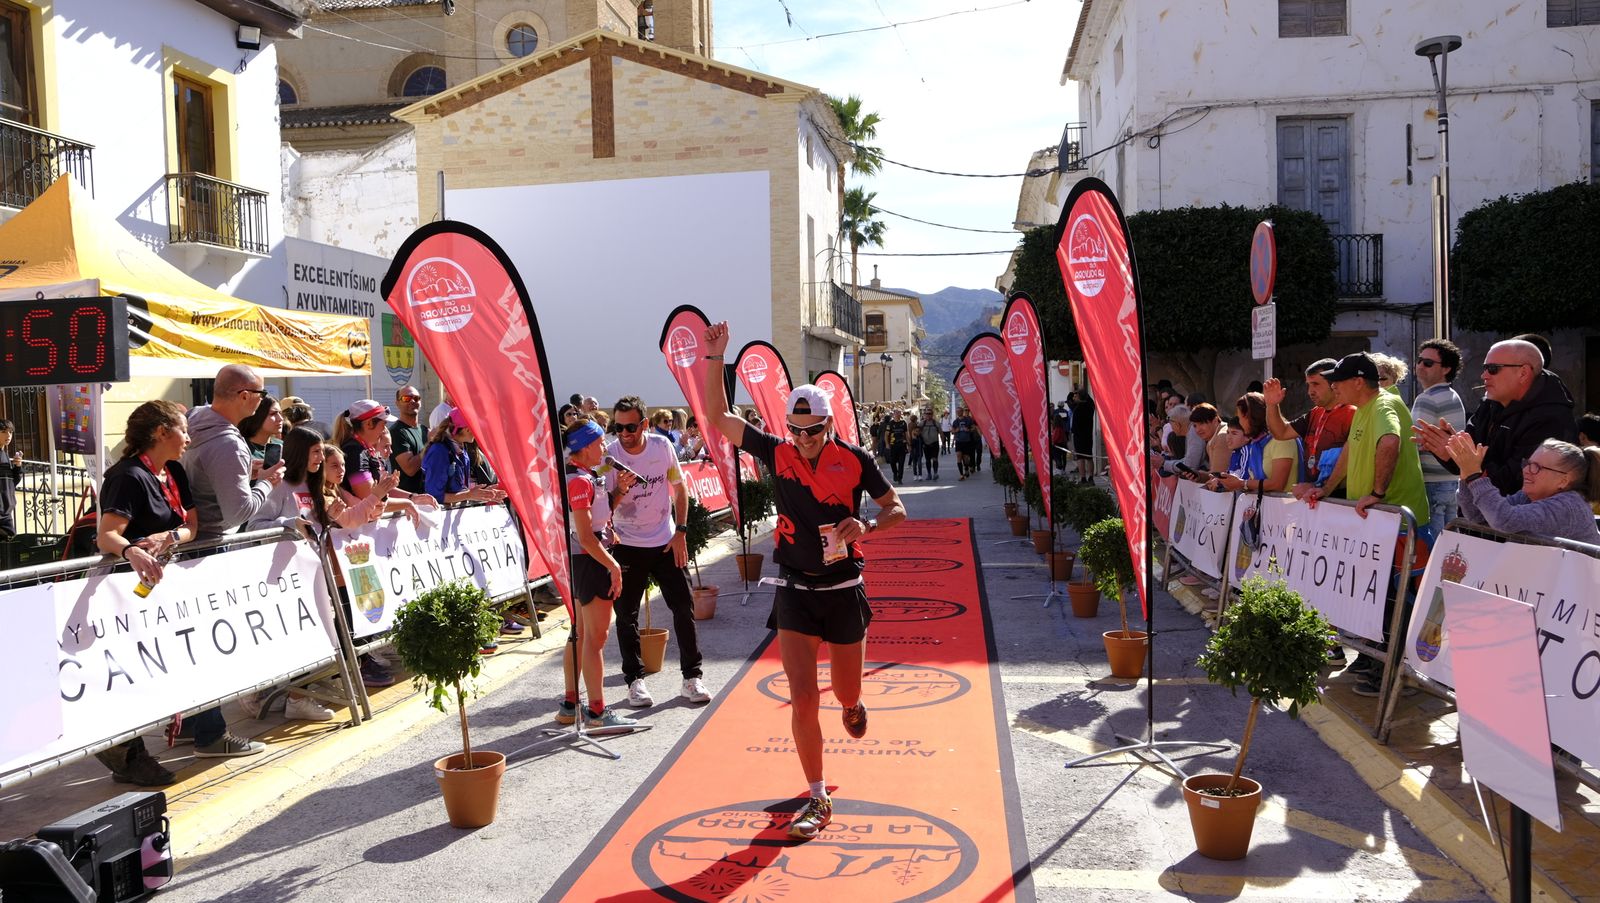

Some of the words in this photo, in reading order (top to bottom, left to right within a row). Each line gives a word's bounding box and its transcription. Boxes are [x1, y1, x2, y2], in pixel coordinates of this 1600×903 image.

[294, 263, 376, 293] EXCELENTÍSIMO
[296, 292, 375, 318] AYUNTAMIENTO
[1360, 541, 1380, 561] DE
[278, 572, 302, 590] DE
[390, 543, 517, 596] CANTORIA
[1254, 543, 1378, 604] CANTORIA
[60, 597, 317, 702] CANTORIA
[746, 746, 937, 758] Ayuntamento
[697, 818, 874, 834] POVORA
[888, 824, 934, 836] LA
